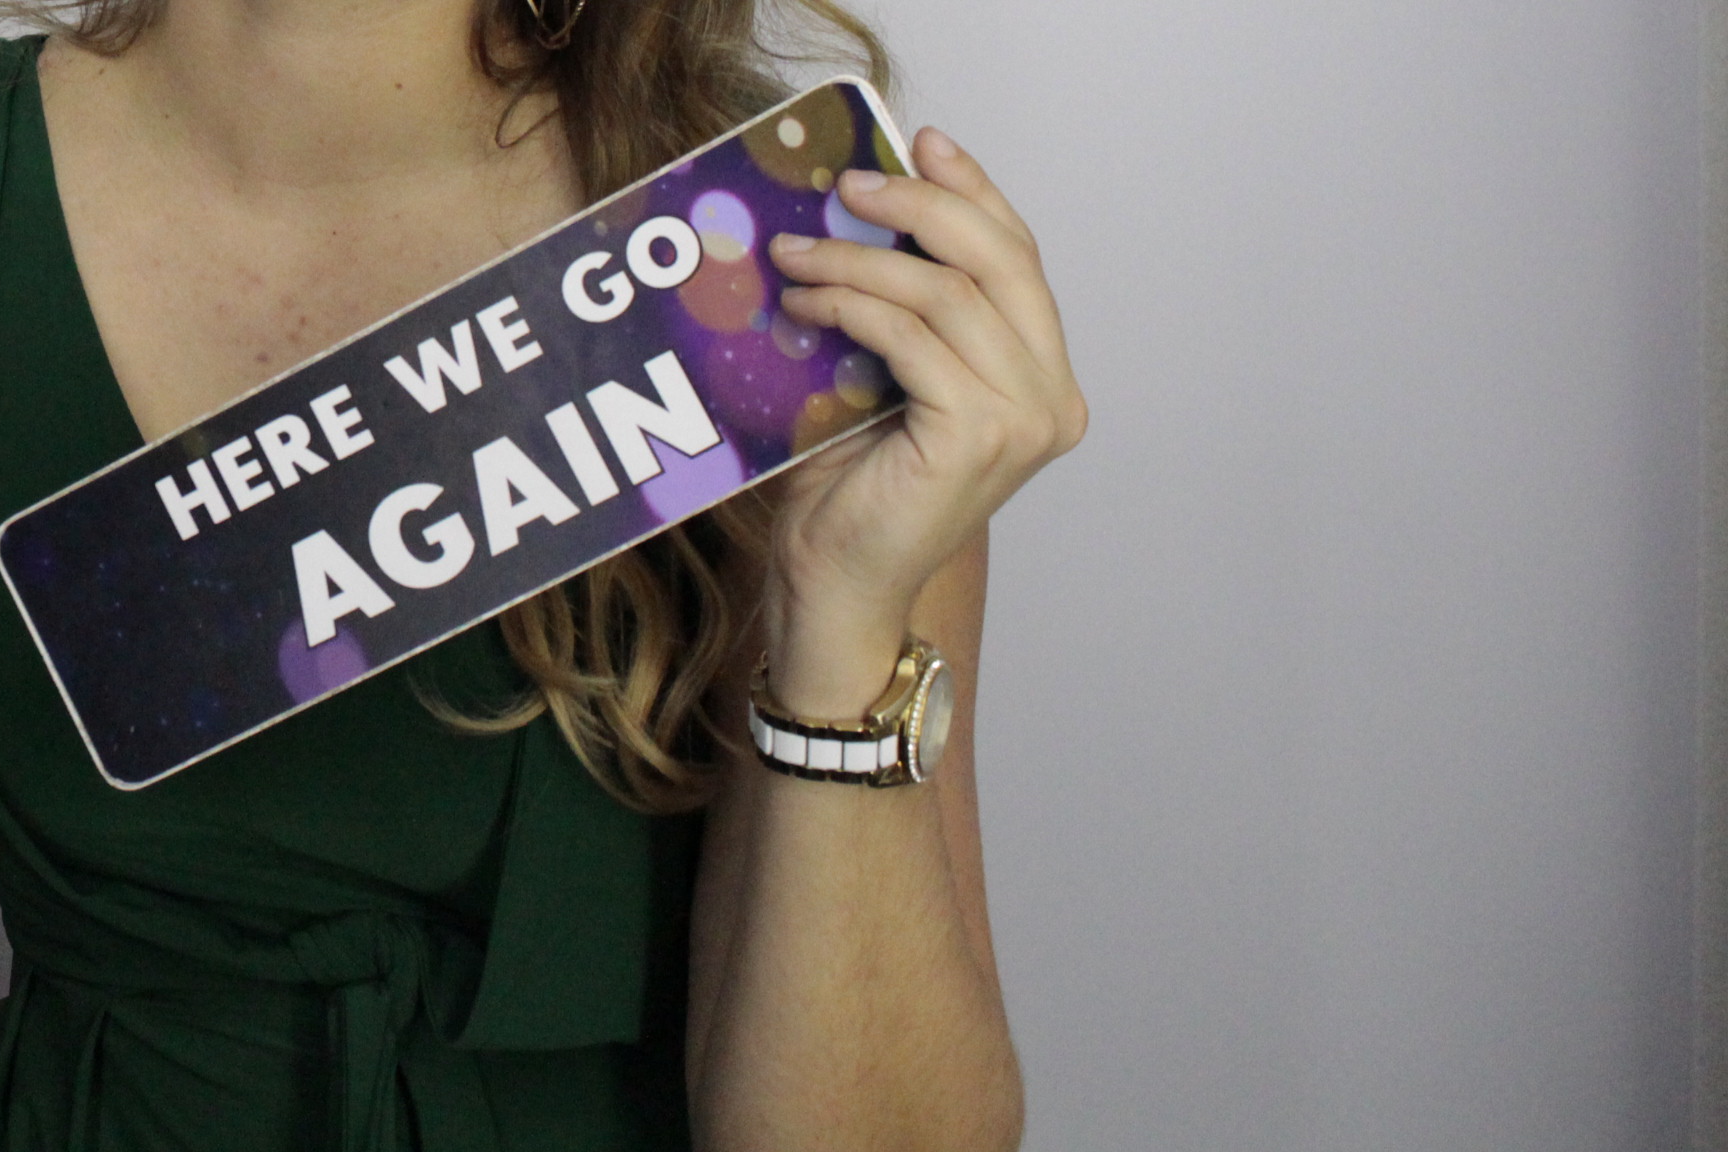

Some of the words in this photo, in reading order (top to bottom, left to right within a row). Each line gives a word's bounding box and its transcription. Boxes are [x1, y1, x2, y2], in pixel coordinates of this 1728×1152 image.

[155, 385, 375, 541] HERE
[384, 295, 544, 414] WE
[561, 214, 701, 323] GO
[291, 350, 722, 648] AGAIN
